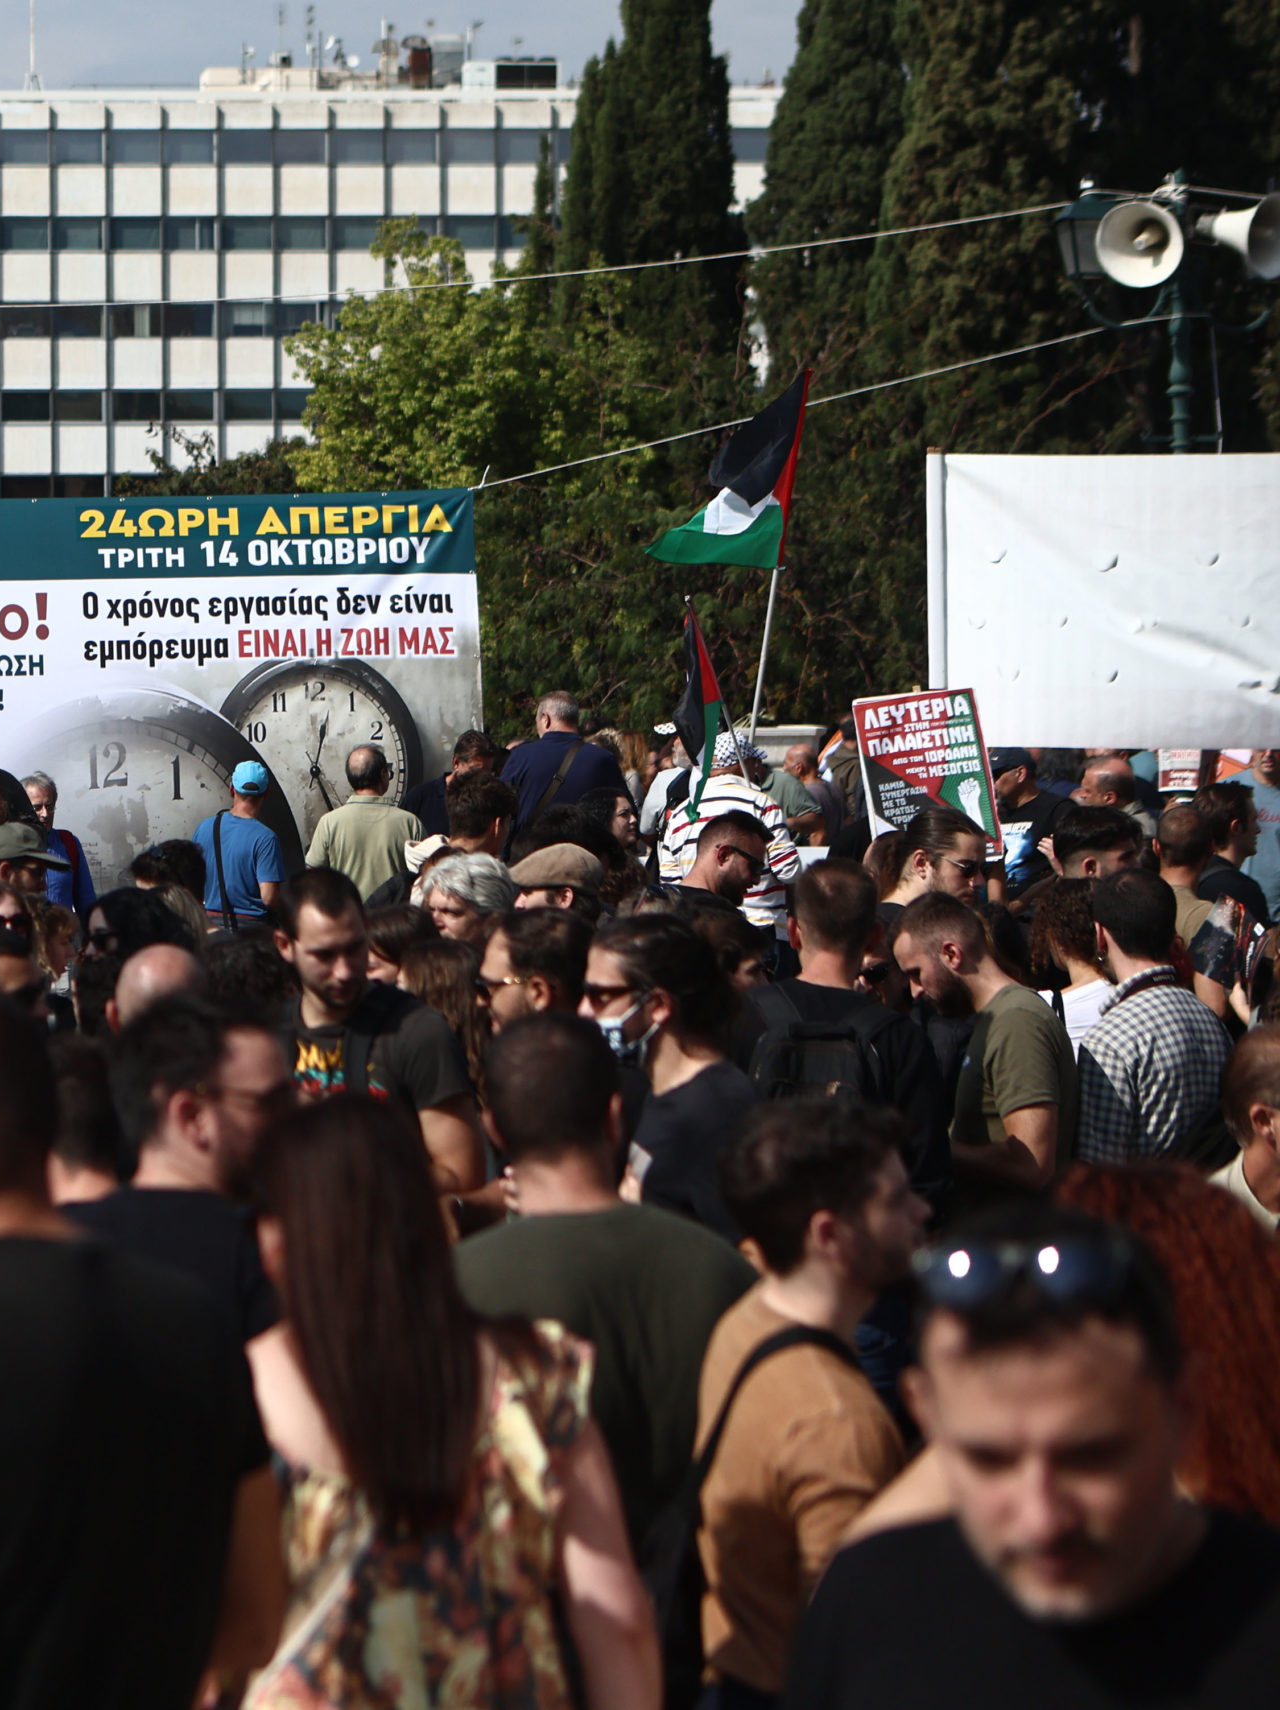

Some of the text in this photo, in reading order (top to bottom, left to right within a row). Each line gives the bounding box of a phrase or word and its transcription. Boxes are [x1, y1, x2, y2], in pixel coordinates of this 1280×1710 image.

[79, 503, 453, 539] 24ΩΡΗ ΑΠΕΡΓΙΑ
[98, 537, 431, 569] ΤΡΙΤΗ 14 ΟΚΤΩΒΡΙΟΥ
[107, 590, 200, 626] χρόνος
[208, 588, 329, 624] εργασίας
[336, 587, 381, 616] δεν
[390, 586, 453, 614] είναι
[83, 626, 455, 668] εμπόρευμα ΕΙΝΑΙ Η ΖΩΗ ΜΑΣ
[272, 691, 287, 713] 11
[303, 681, 326, 702] 12
[348, 691, 355, 712] 1
[864, 695, 970, 730] ΛΕΥΤΕΡΙΑ
[246, 721, 267, 743] 10
[370, 720, 383, 741] 2
[904, 721, 930, 733] ΣΤΗΝ
[867, 724, 975, 757] ΠΑΛΑΙΣΤΙΝΗ
[924, 744, 978, 763] ΙΟΡΔΑΝΗ
[88, 742, 128, 790] 12
[928, 759, 981, 778] ΜΕΣΟΓΕΙΟ
[171, 755, 184, 801] 1
[878, 780, 905, 792] ΚΑΜΙΑ
[880, 785, 928, 801] ΣΥΝΕΡΓΑΣΙΑ
[882, 797, 907, 809] ΜΕ ΤΟ
